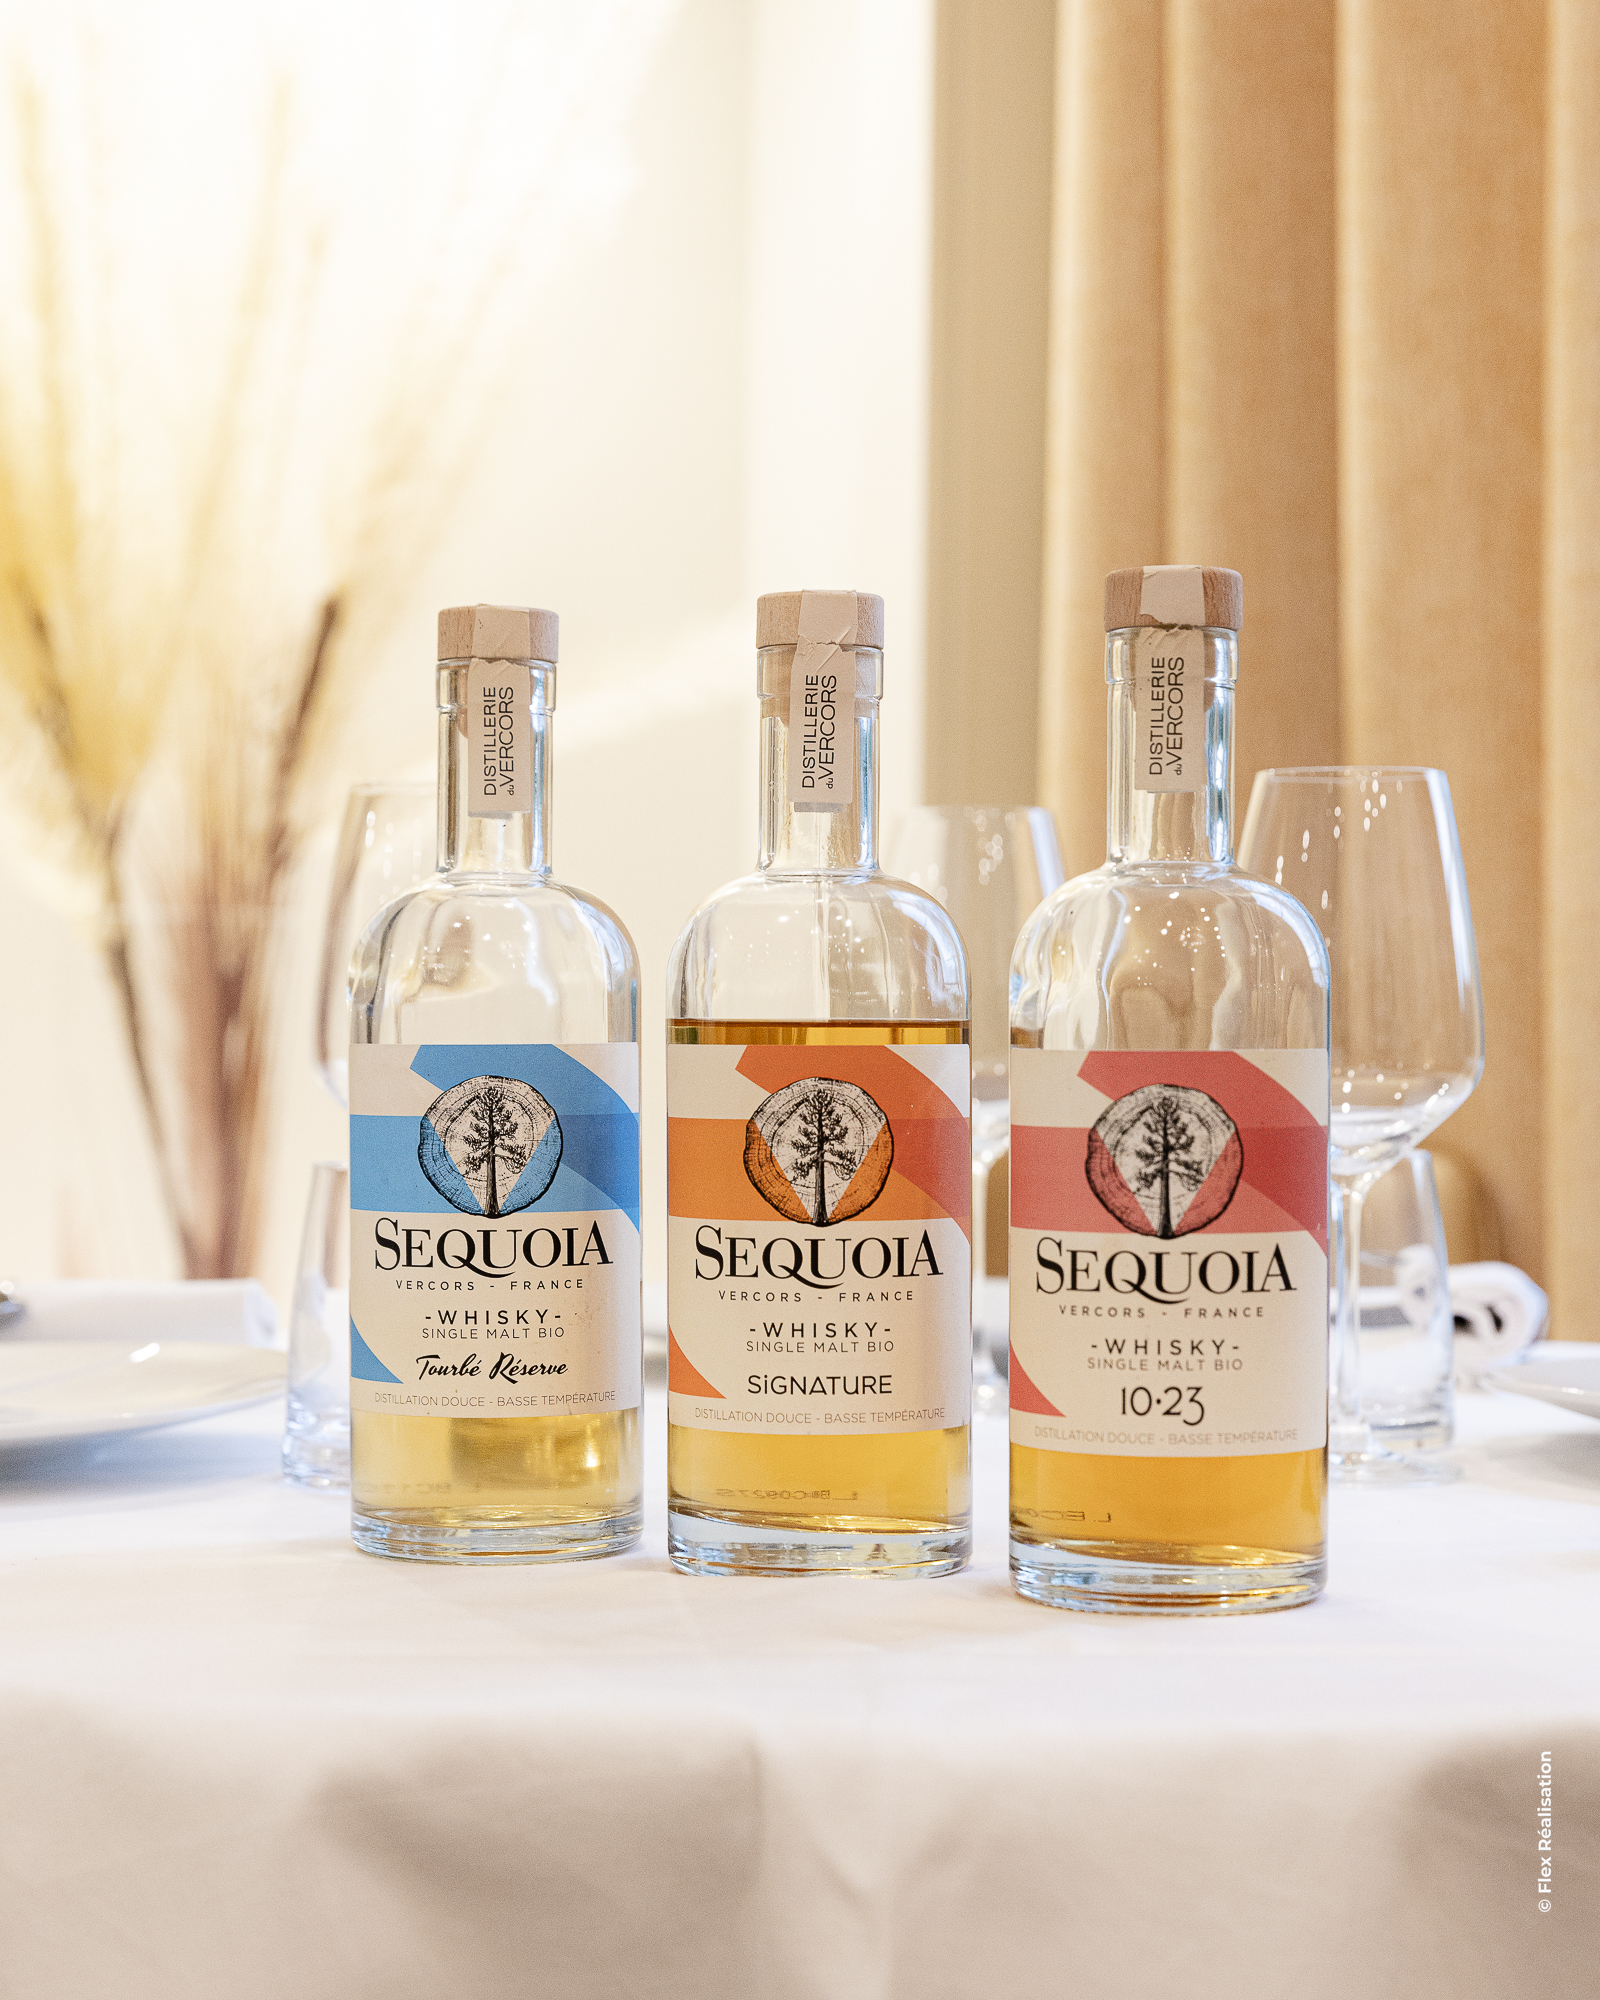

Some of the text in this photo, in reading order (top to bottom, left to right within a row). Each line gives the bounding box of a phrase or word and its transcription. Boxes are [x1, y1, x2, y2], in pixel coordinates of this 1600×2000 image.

[802, 674, 818, 788] DISTILLERIE
[818, 674, 837, 789] du VERCORS
[1149, 657, 1165, 775] DISTILLERIE
[1166, 656, 1184, 776] du VERCORS
[483, 686, 496, 796] DISTILLERIE
[499, 686, 515, 796] du VERCORS
[375, 1217, 613, 1278] SEQUOIA
[695, 1224, 943, 1289] SEQUOIA
[396, 1279, 475, 1291] VERCORS
[510, 1278, 584, 1290] FRANCE
[1036, 1236, 1297, 1304] SEQUOIA
[718, 1290, 803, 1303] VERCORS
[839, 1290, 915, 1302] FRANCE
[1059, 1304, 1146, 1318] VERCORS
[1184, 1305, 1264, 1318] FRANCE
[422, 1327, 565, 1339] SINGLE MALT BIO
[746, 1340, 895, 1353] SINGLE MALT BIO
[415, 1352, 568, 1384] Tourbé Réserve
[1087, 1357, 1243, 1371] SINGLE MALT BIO
[374, 1392, 438, 1406] DISTILLATION
[441, 1396, 485, 1407] DOUCE
[497, 1396, 538, 1407] BASSE
[541, 1390, 616, 1406] TEMPÉRATURE
[694, 1407, 762, 1422] DISTILLATION
[766, 1412, 812, 1424] DOUCE
[824, 1412, 866, 1424] BASSE
[870, 1407, 945, 1422] TEMPÉRATURE
[1034, 1425, 1104, 1442] DISTILLATION
[1107, 1431, 1156, 1445] DOUCE
[1168, 1432, 1213, 1446] BASSE
[1217, 1428, 1298, 1444] TEMPÉRATURE
